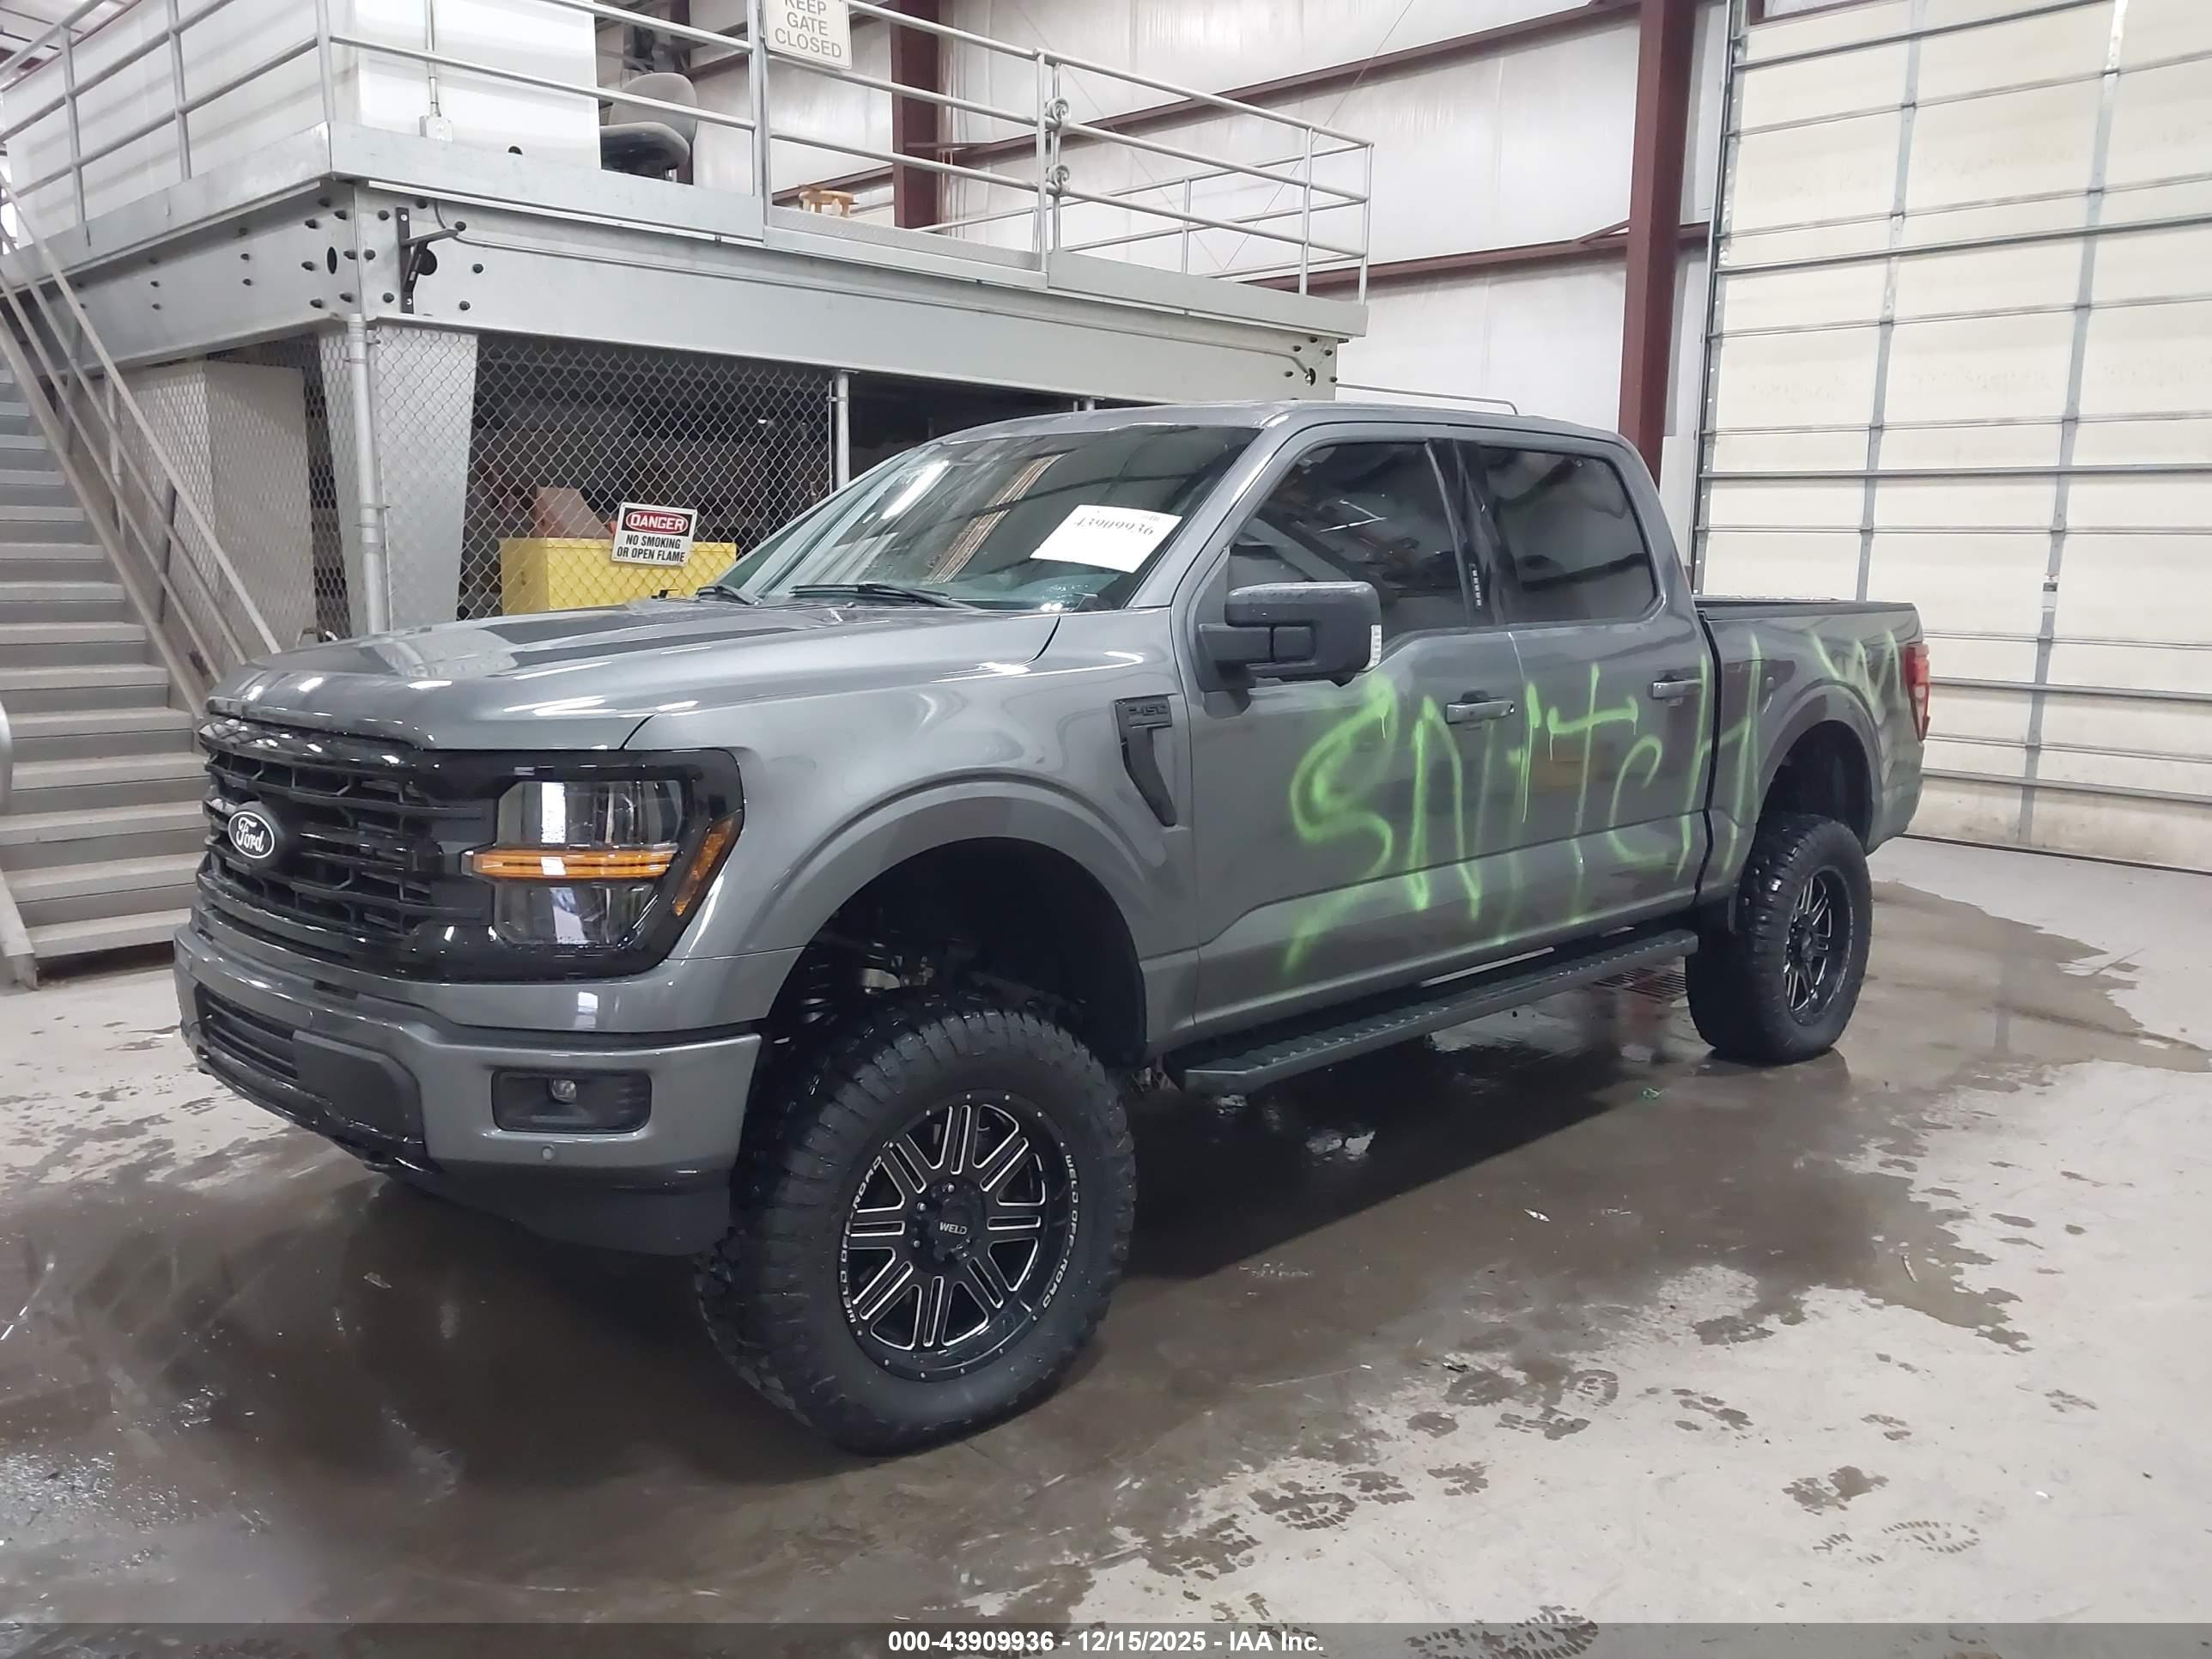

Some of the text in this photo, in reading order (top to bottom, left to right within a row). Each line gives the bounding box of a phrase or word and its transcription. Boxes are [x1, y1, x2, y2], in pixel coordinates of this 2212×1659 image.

[787, 11, 828, 36] GATE
[775, 27, 842, 58] CLOSED
[629, 514, 684, 531] DANGER
[626, 534, 681, 550] NO SMOKING
[617, 546, 685, 562] OR OPEN FLAME
[236, 817, 264, 853] Ford
[939, 1221, 968, 1235] WELD
